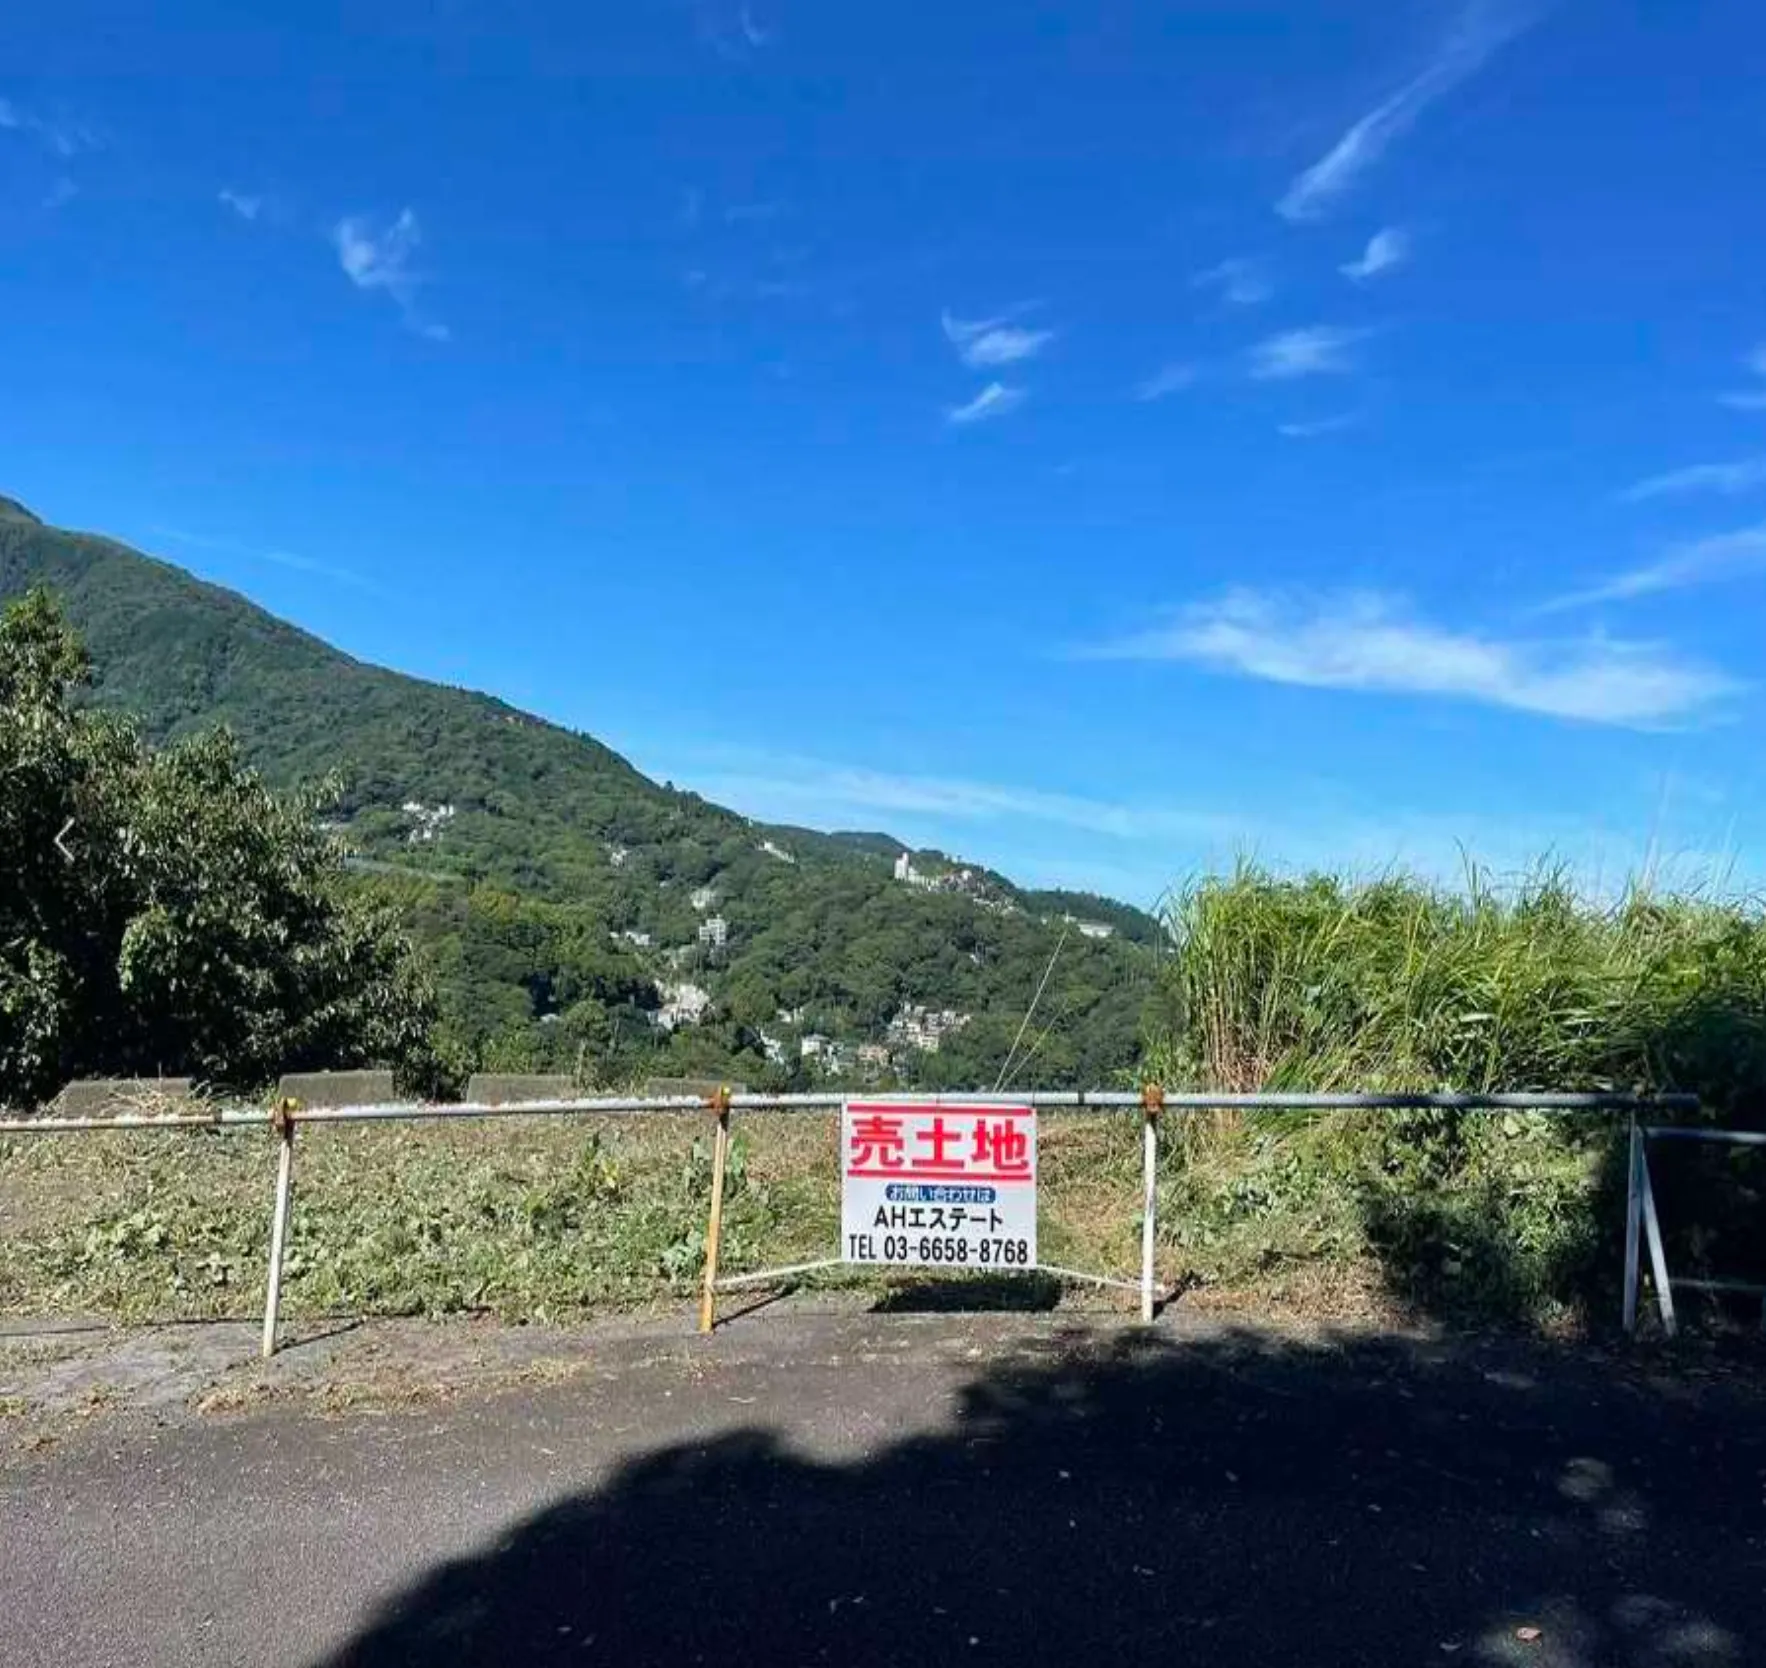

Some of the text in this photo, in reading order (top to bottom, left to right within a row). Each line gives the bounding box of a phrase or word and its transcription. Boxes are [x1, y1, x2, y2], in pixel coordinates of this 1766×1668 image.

[850, 1115, 1030, 1171] 売土地
[874, 1205, 1004, 1233] AHエステート
[849, 1234, 1028, 1264] TEL 03-6658-8768
